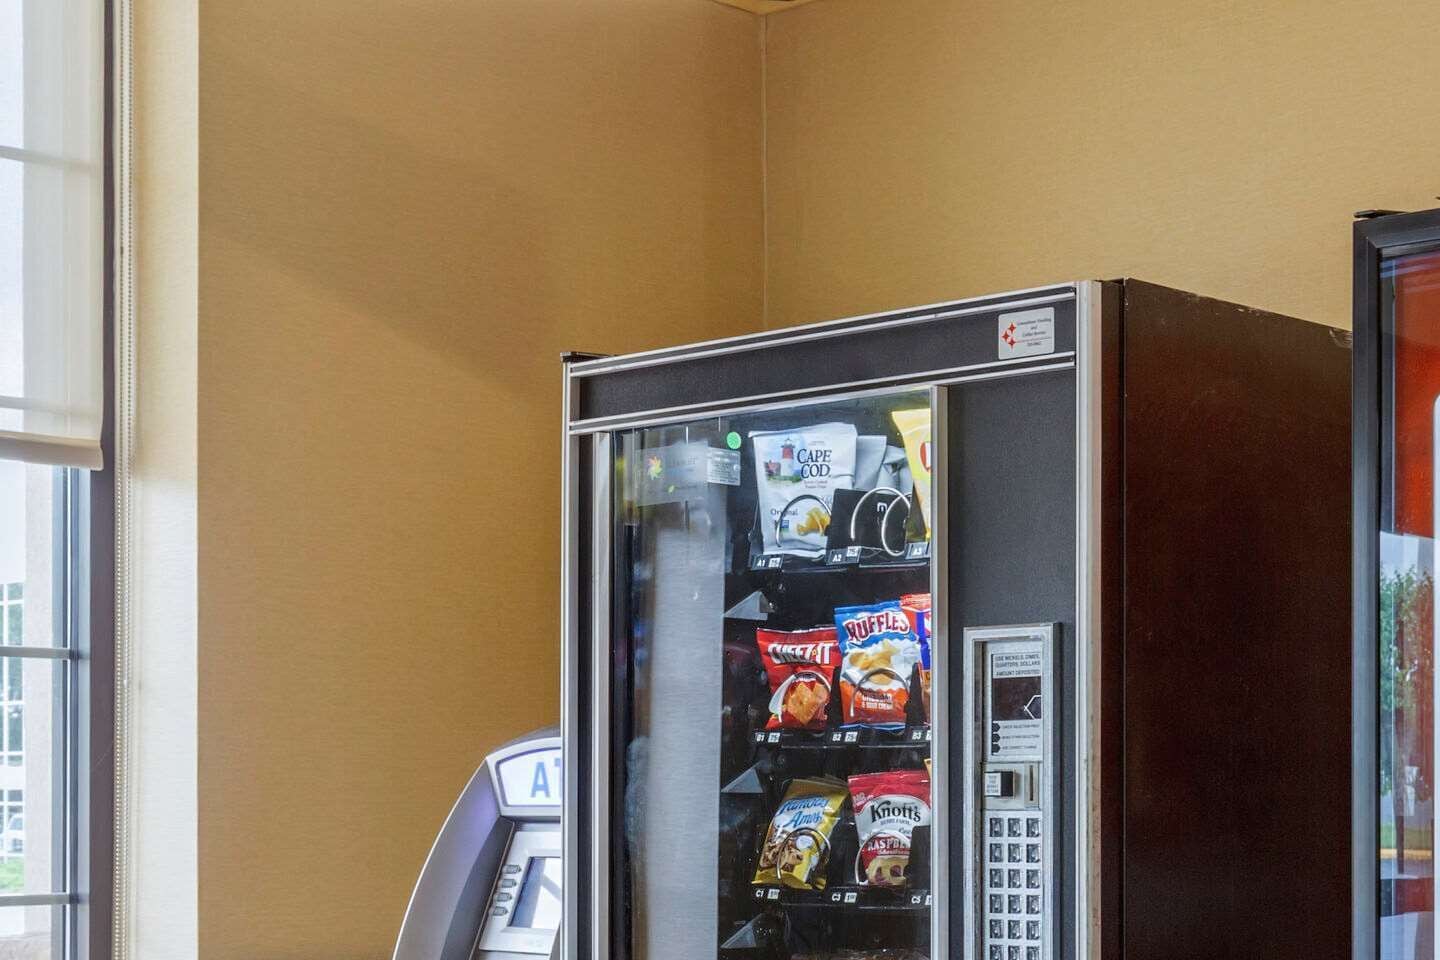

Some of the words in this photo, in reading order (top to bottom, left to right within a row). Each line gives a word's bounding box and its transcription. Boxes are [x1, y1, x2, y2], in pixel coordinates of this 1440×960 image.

[797, 449, 832, 464] CAPE
[801, 464, 830, 479] COD
[844, 612, 909, 640] RUFFLES
[832, 733, 841, 741] B2
[912, 731, 922, 739] B3
[784, 811, 823, 828] Amos
[871, 801, 921, 823] Knott's
